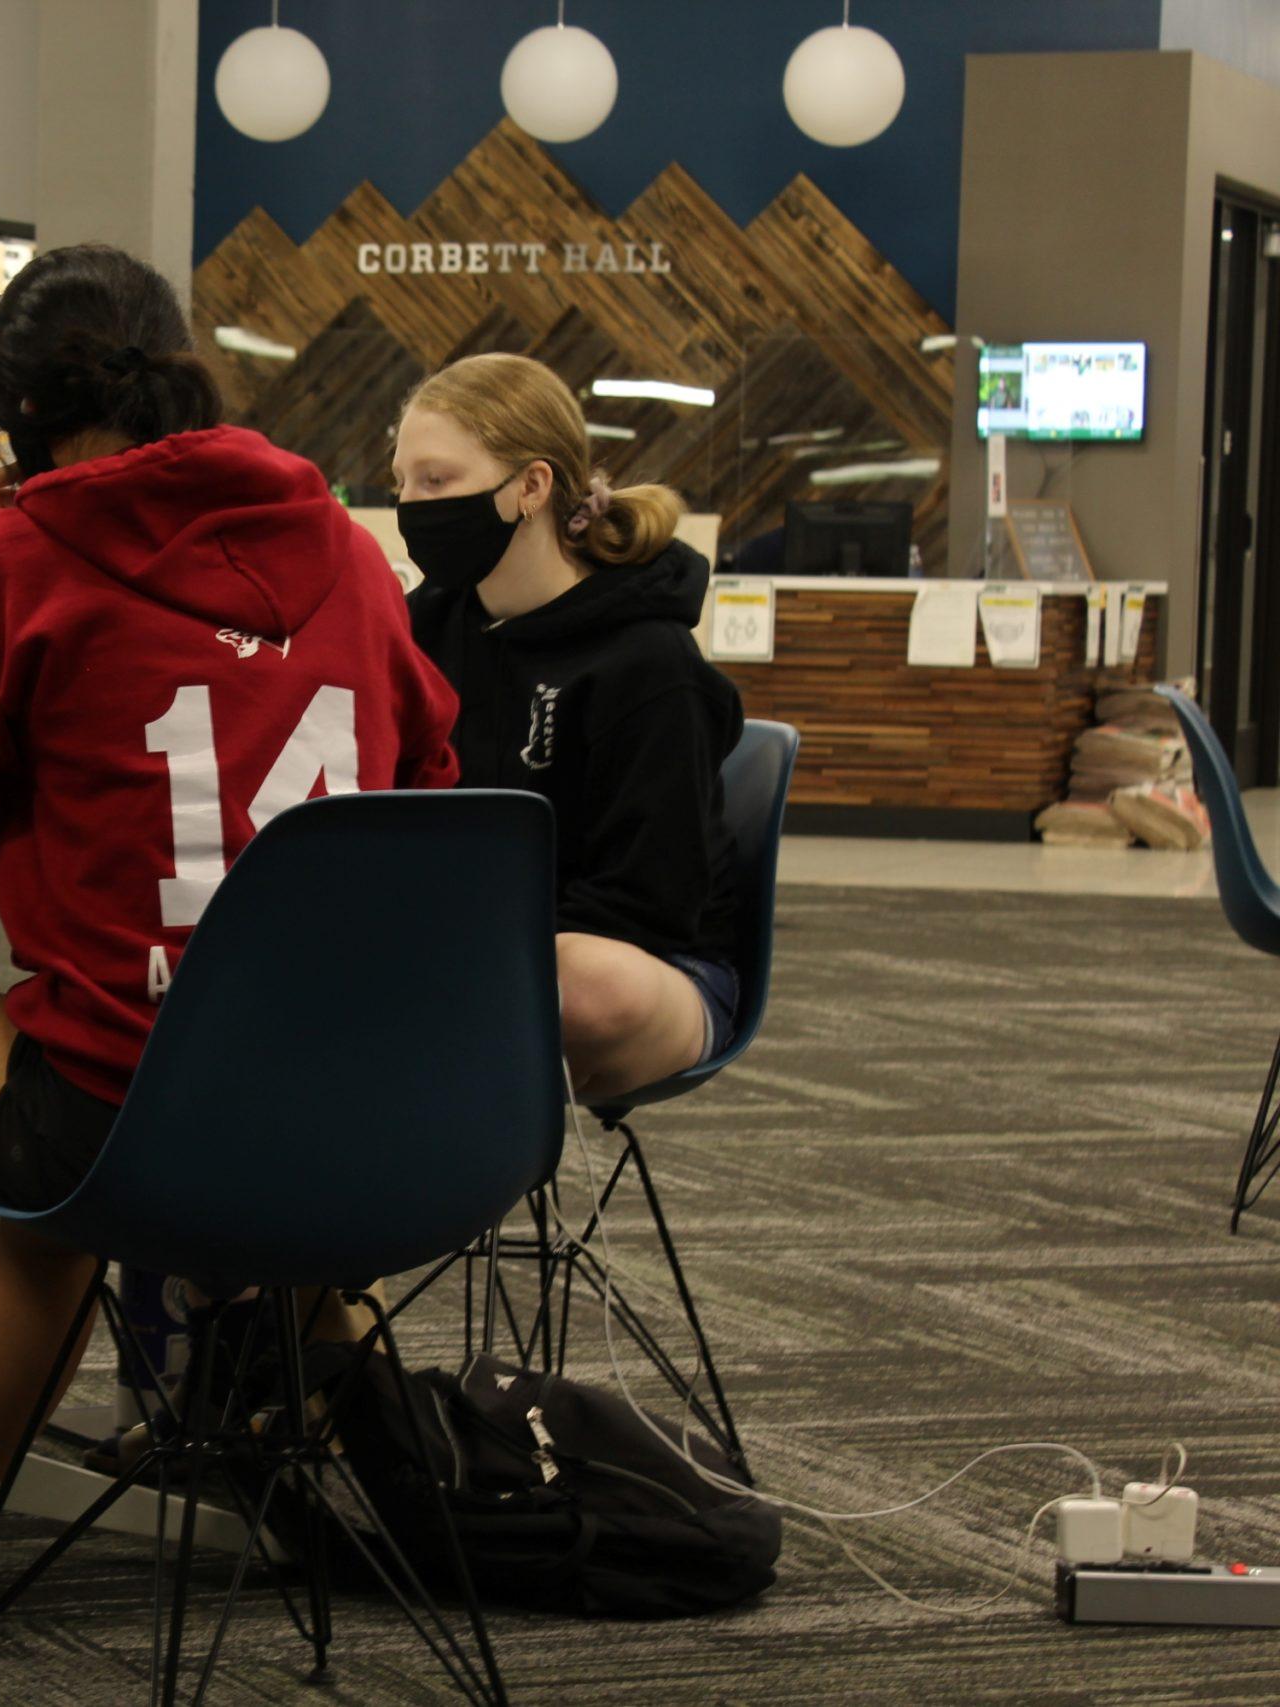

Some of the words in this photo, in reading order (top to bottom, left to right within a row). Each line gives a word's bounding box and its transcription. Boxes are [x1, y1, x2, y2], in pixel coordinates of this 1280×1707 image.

[357, 242, 546, 275] CORBETT
[563, 242, 672, 275] HALL
[144, 684, 360, 928] 14
